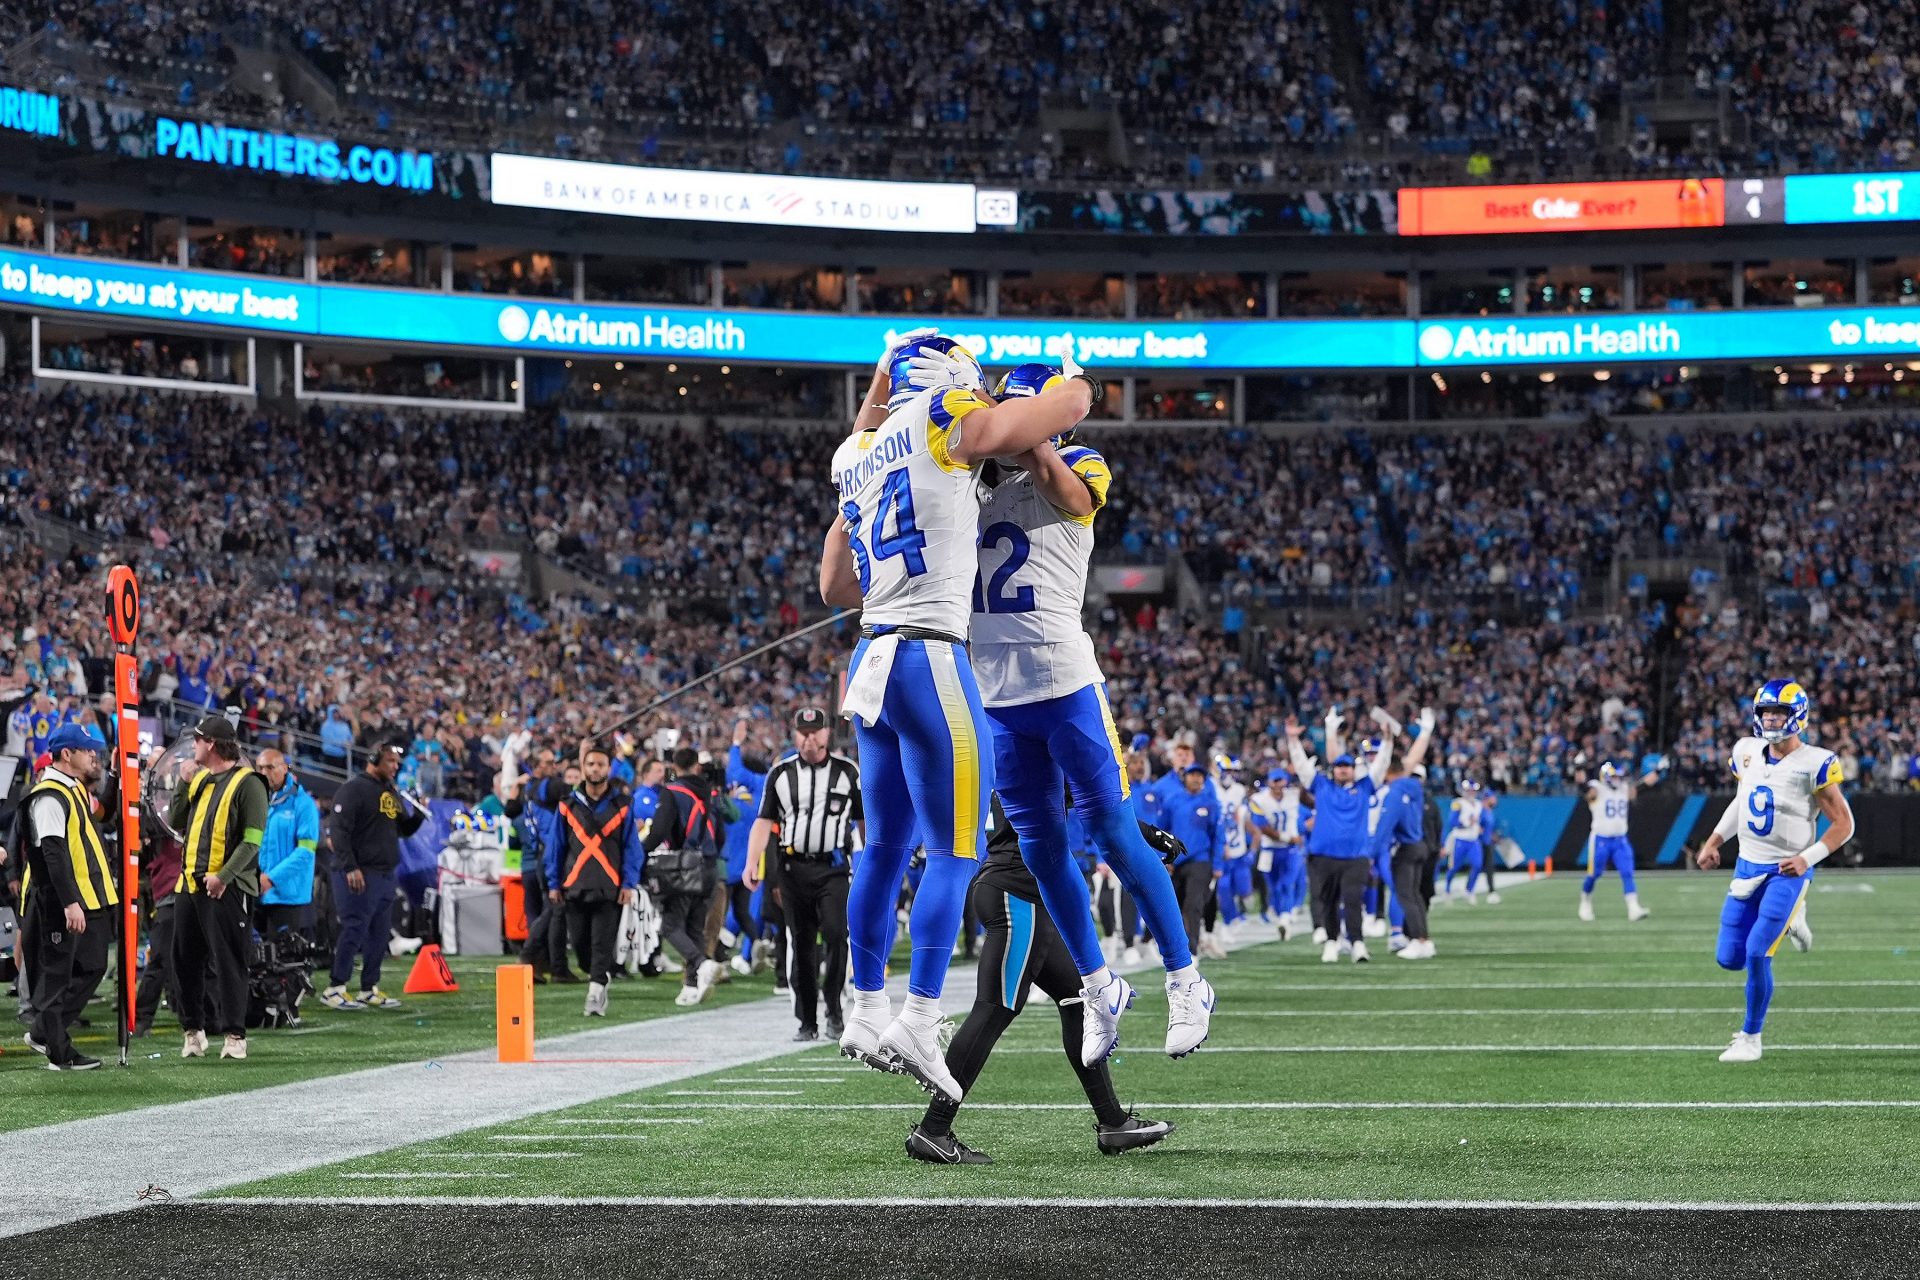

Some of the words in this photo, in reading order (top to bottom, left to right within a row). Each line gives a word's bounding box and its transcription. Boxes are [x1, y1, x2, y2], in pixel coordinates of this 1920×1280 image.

[0, 86, 60, 137] RUM
[156, 117, 434, 191] PANTHERS.COM
[543, 181, 601, 201] BANK
[611, 187, 636, 204] OF
[645, 190, 752, 212] AMERICA
[815, 201, 921, 220] STADIUM
[1484, 202, 1529, 219] Best
[1532, 197, 1580, 220] Coke
[1582, 200, 1637, 216] Ever?
[1852, 180, 1904, 215] 1ST
[1, 263, 27, 292] to
[30, 264, 92, 302] keep
[97, 278, 145, 308] you
[149, 280, 177, 309] at
[179, 288, 240, 316] your
[242, 287, 299, 321] best
[529, 308, 640, 347] Atrium
[644, 315, 745, 350] Health
[989, 335, 1042, 361] you
[1045, 331, 1075, 357] at
[1078, 336, 1141, 363] your
[1143, 331, 1207, 358] best
[1454, 325, 1570, 357] Atrium
[1574, 321, 1680, 354] Health
[1828, 318, 1862, 345] to
[972, 521, 1036, 614] 2
[1747, 785, 1775, 837] 9
